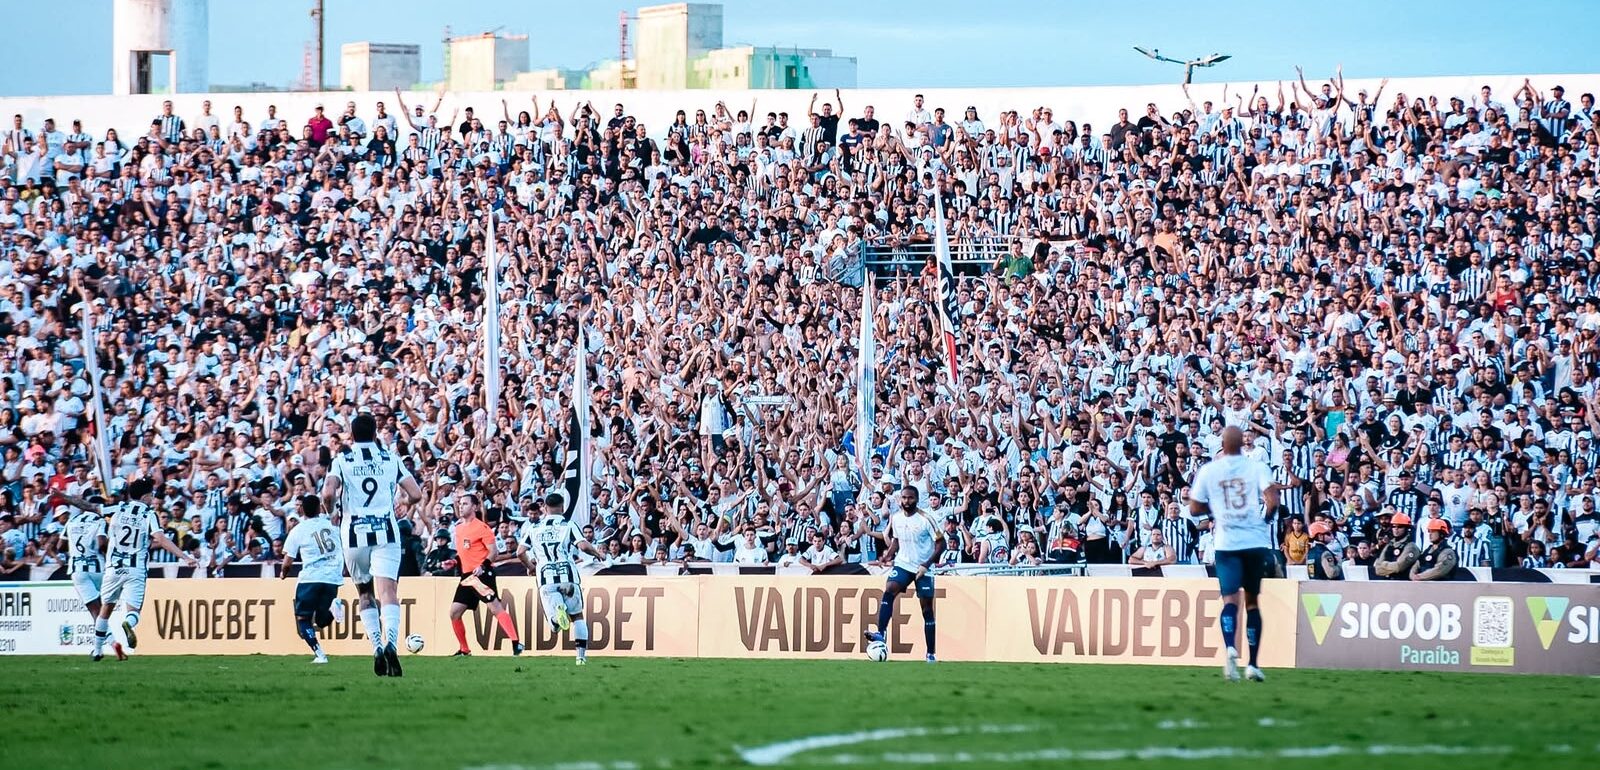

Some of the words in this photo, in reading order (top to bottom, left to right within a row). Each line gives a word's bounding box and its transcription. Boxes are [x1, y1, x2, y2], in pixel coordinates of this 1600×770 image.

[361, 477, 378, 508] 9
[1219, 478, 1248, 510] 13
[75, 535, 85, 554] 6
[119, 525, 140, 549] 21
[310, 528, 336, 555] 16
[541, 542, 561, 562] 17
[0, 592, 32, 616] RIA
[154, 599, 275, 640] VAIDEBET
[1339, 601, 1463, 641] SICOOB
[1568, 605, 1600, 643] SI
[1400, 645, 1460, 665] Paraíba
